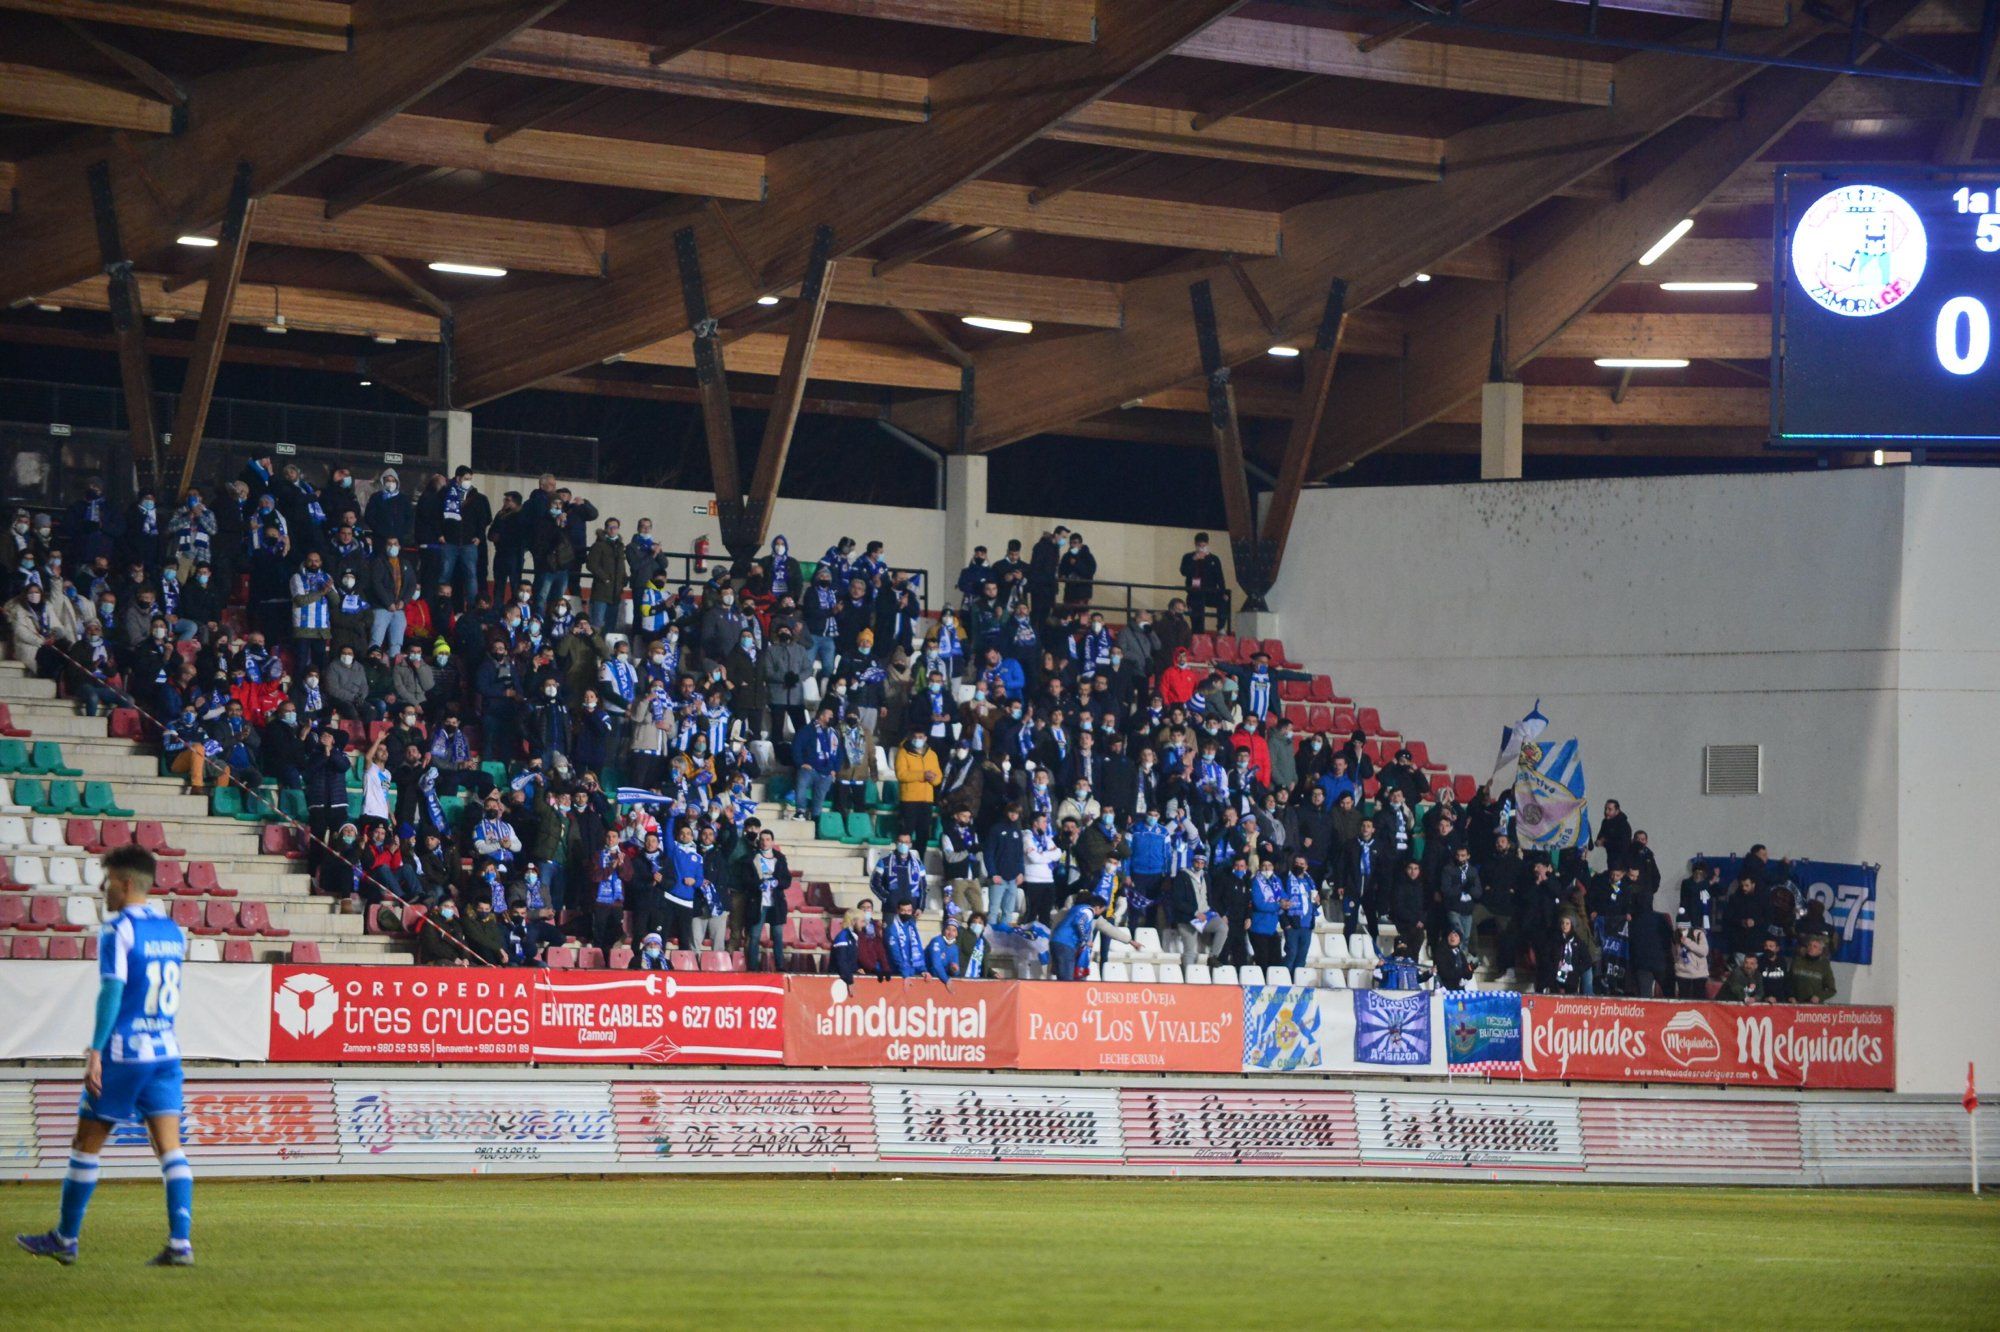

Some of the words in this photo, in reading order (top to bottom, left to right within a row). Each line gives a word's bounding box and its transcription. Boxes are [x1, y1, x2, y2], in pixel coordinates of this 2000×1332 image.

[1811, 281, 1881, 313] ZAMORA
[1936, 296, 1990, 375] 0
[144, 960, 181, 1017] 18
[346, 980, 528, 998] ORTOPEDIA
[344, 1001, 411, 1034] tres
[422, 1006, 530, 1035] cruces
[541, 1003, 594, 1026] ENTRE
[599, 1004, 664, 1027] CABLES
[682, 1006, 710, 1028] 627
[715, 1006, 743, 1029] 051
[748, 1007, 777, 1029] 192
[817, 1013, 832, 1035] la
[835, 997, 987, 1038] industrial
[1554, 1001, 1592, 1015] Jamones
[1592, 1006, 1599, 1018] y
[1600, 1003, 1645, 1017] Embutidos
[1794, 1011, 1831, 1023] Jamones
[1832, 1014, 1837, 1026] y
[1839, 1010, 1883, 1025] Embutidos
[343, 1043, 372, 1053] Zamora
[377, 1043, 395, 1053] 980
[396, 1043, 407, 1053] 52
[408, 1043, 418, 1053] 53
[420, 1043, 430, 1053] 55
[436, 1043, 473, 1054] Benavente
[479, 1044, 495, 1054] 980
[578, 1028, 617, 1044] (Zamora)
[886, 1039, 911, 1061] de
[913, 1040, 987, 1065] pinturas
[1100, 1053, 1130, 1065] LECHE
[1132, 1053, 1165, 1066] CRUDA
[1736, 1016, 1883, 1085] Melquiades
[190, 1095, 317, 1144] SEUR
[684, 1125, 726, 1157] DE
